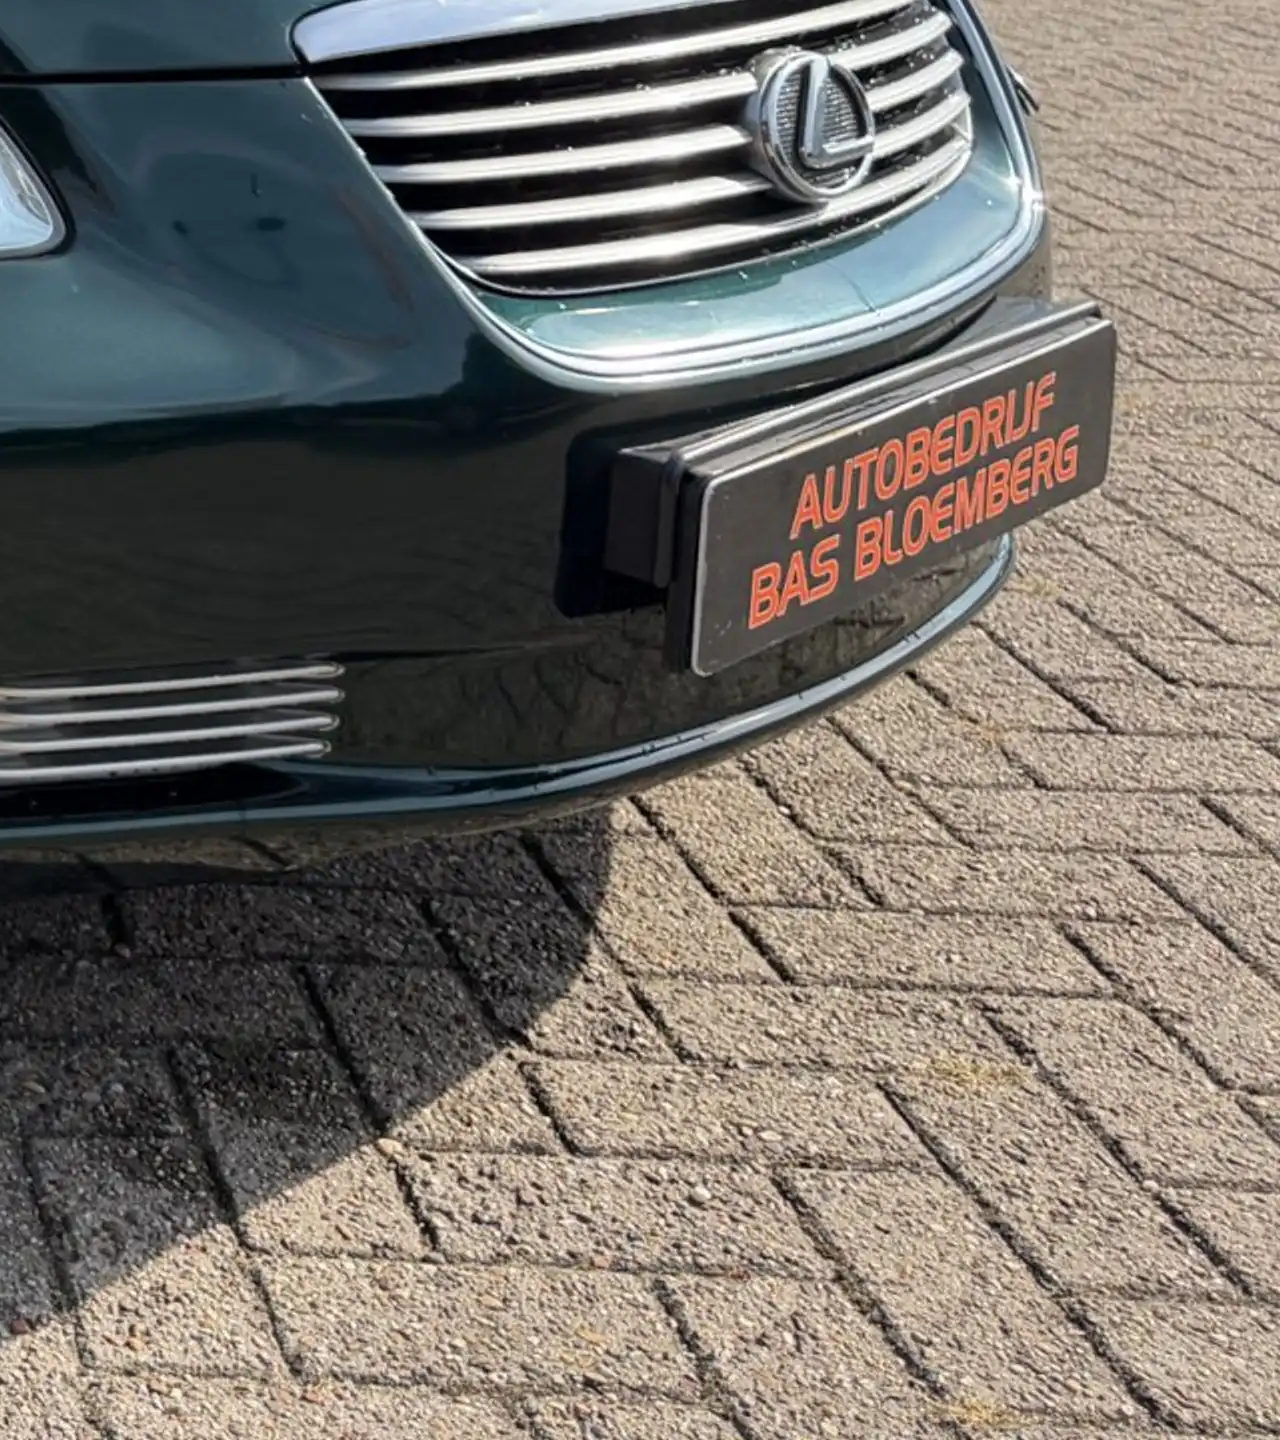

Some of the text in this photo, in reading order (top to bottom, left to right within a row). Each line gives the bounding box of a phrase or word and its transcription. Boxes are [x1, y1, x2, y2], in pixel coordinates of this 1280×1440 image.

[747, 424, 1081, 631] BAS BLOEMBERG
[788, 370, 1057, 541] AUTOBEDRIJF
